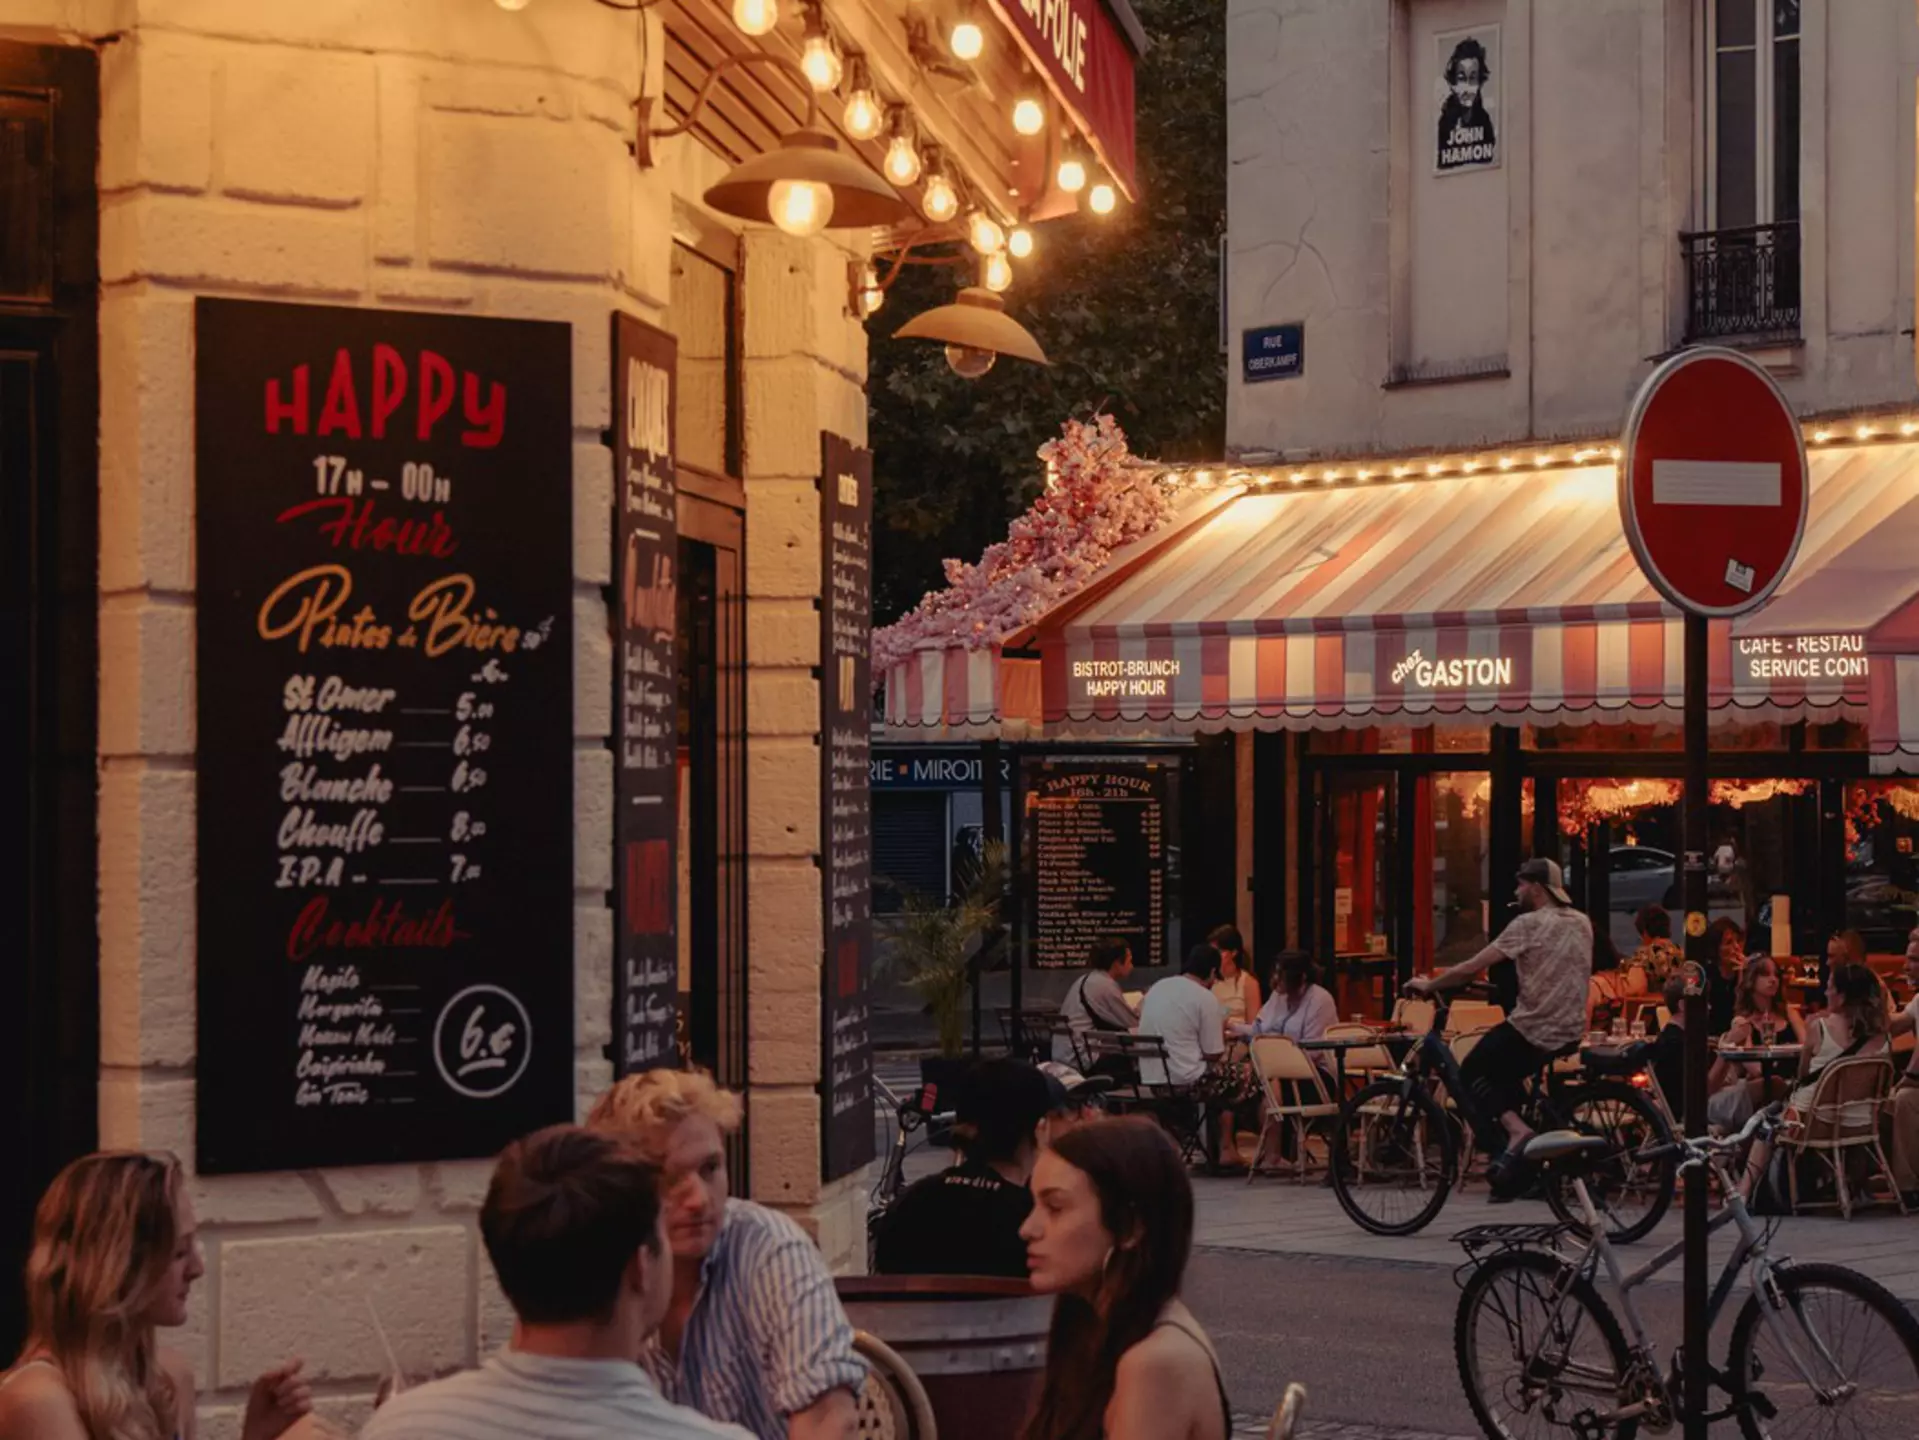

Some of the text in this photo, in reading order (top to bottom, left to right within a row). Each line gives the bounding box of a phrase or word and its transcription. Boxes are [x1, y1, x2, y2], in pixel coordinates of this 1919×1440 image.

[1447, 126, 1485, 146] JOHN
[1441, 143, 1493, 165] HAMON
[1262, 335, 1283, 349] RUE
[264, 341, 508, 449] HAPPY
[275, 496, 461, 559] Hour
[257, 563, 394, 654] Pintes
[1796, 635, 1863, 653] RESTAU
[1073, 660, 1180, 677] BISTROT-BRUNCH
[1391, 649, 1421, 684] chez
[1415, 658, 1512, 687] GASTON
[1749, 658, 1821, 677] SERVICE
[282, 673, 317, 713] St
[316, 673, 397, 714] Omer
[1086, 679, 1167, 696] HAPPY HOUR
[275, 712, 394, 763] Affligem
[278, 760, 395, 804] Blanche
[1046, 774, 1152, 793] HAPPY HOUR
[276, 805, 385, 855] Chouffe
[286, 894, 474, 964] Cocktails
[300, 964, 361, 996] Mojito
[297, 993, 384, 1024] Margarita
